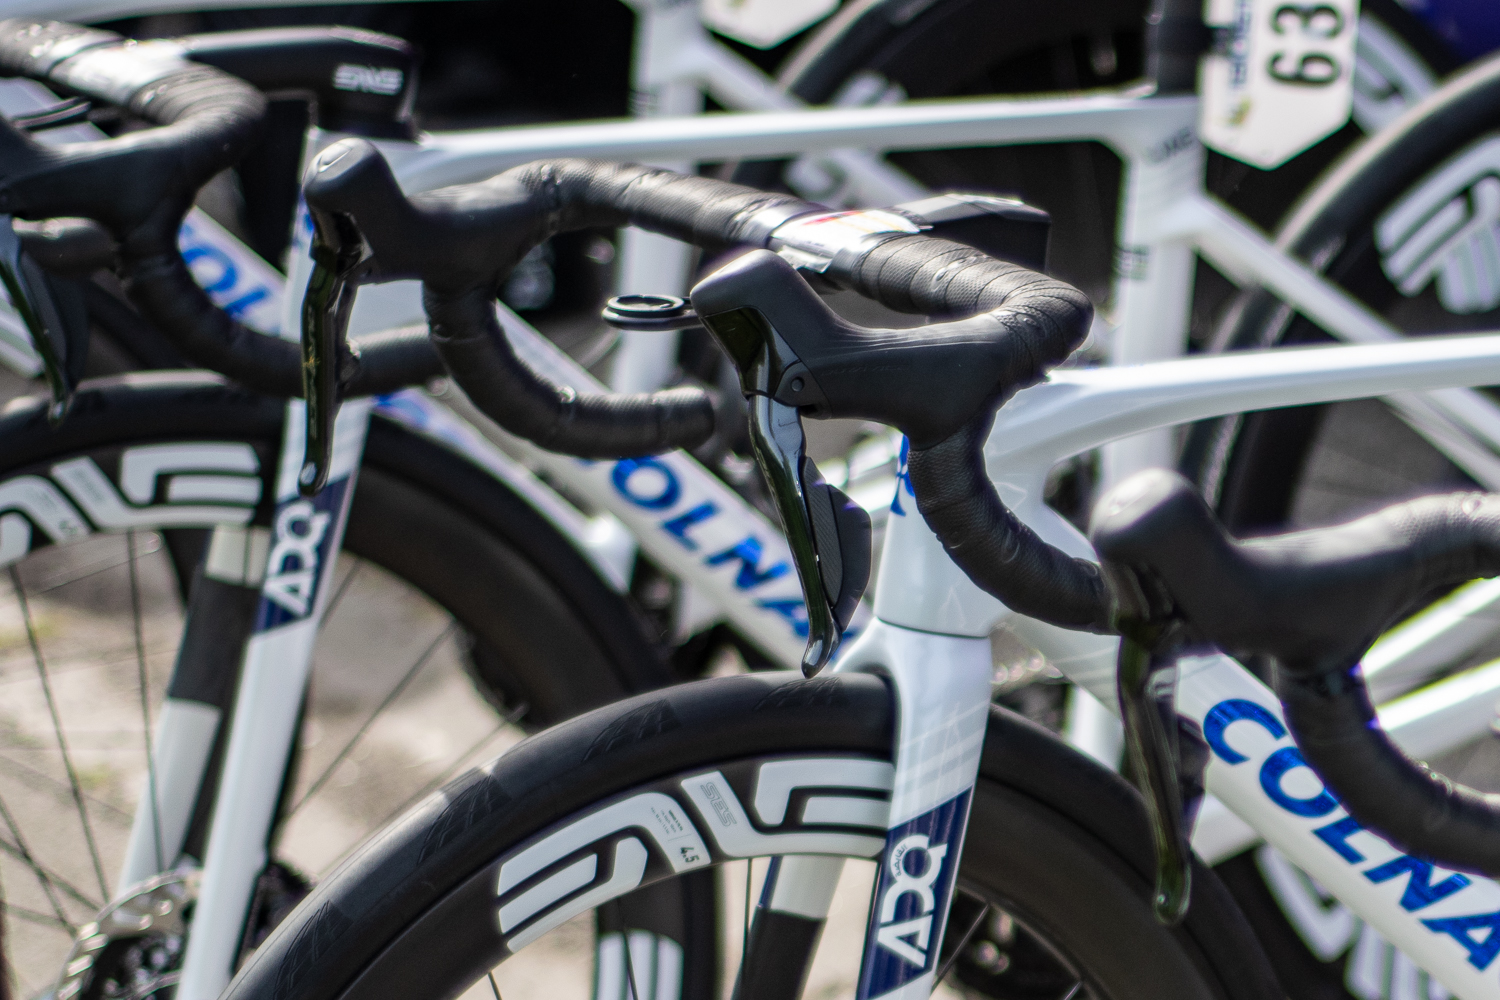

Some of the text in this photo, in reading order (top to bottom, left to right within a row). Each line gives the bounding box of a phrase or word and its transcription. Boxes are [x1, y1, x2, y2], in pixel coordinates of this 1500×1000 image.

[1268, 4, 1344, 88] 63
[264, 500, 331, 616] ADQ
[680, 845, 700, 864] 4.5
[877, 833, 949, 969] ADQ
